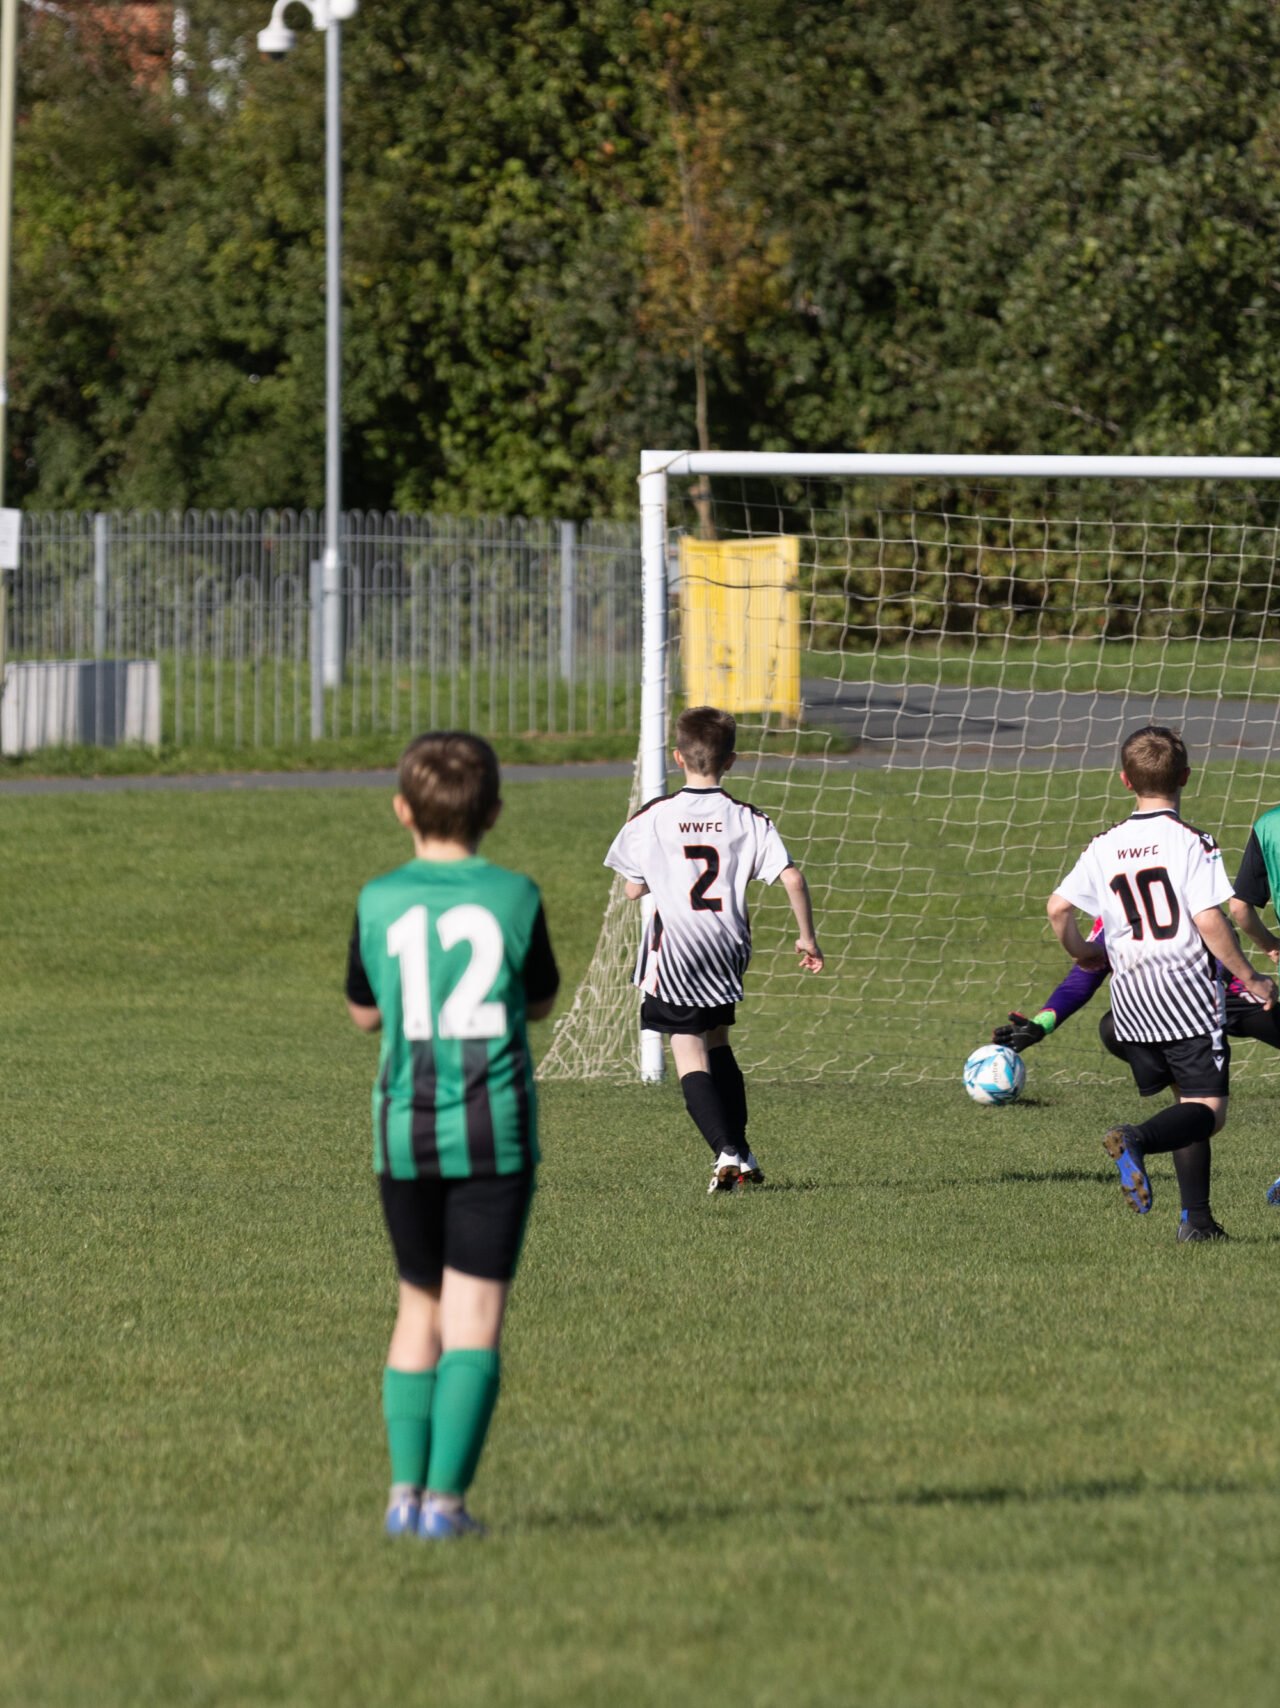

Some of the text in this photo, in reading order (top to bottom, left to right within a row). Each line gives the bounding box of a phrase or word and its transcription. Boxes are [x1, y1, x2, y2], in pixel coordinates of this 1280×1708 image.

[679, 822, 723, 833] WWFC
[1117, 844, 1159, 859] WWFC
[683, 844, 723, 912] 2
[1109, 866, 1180, 941] 10
[386, 903, 507, 1041] 12
